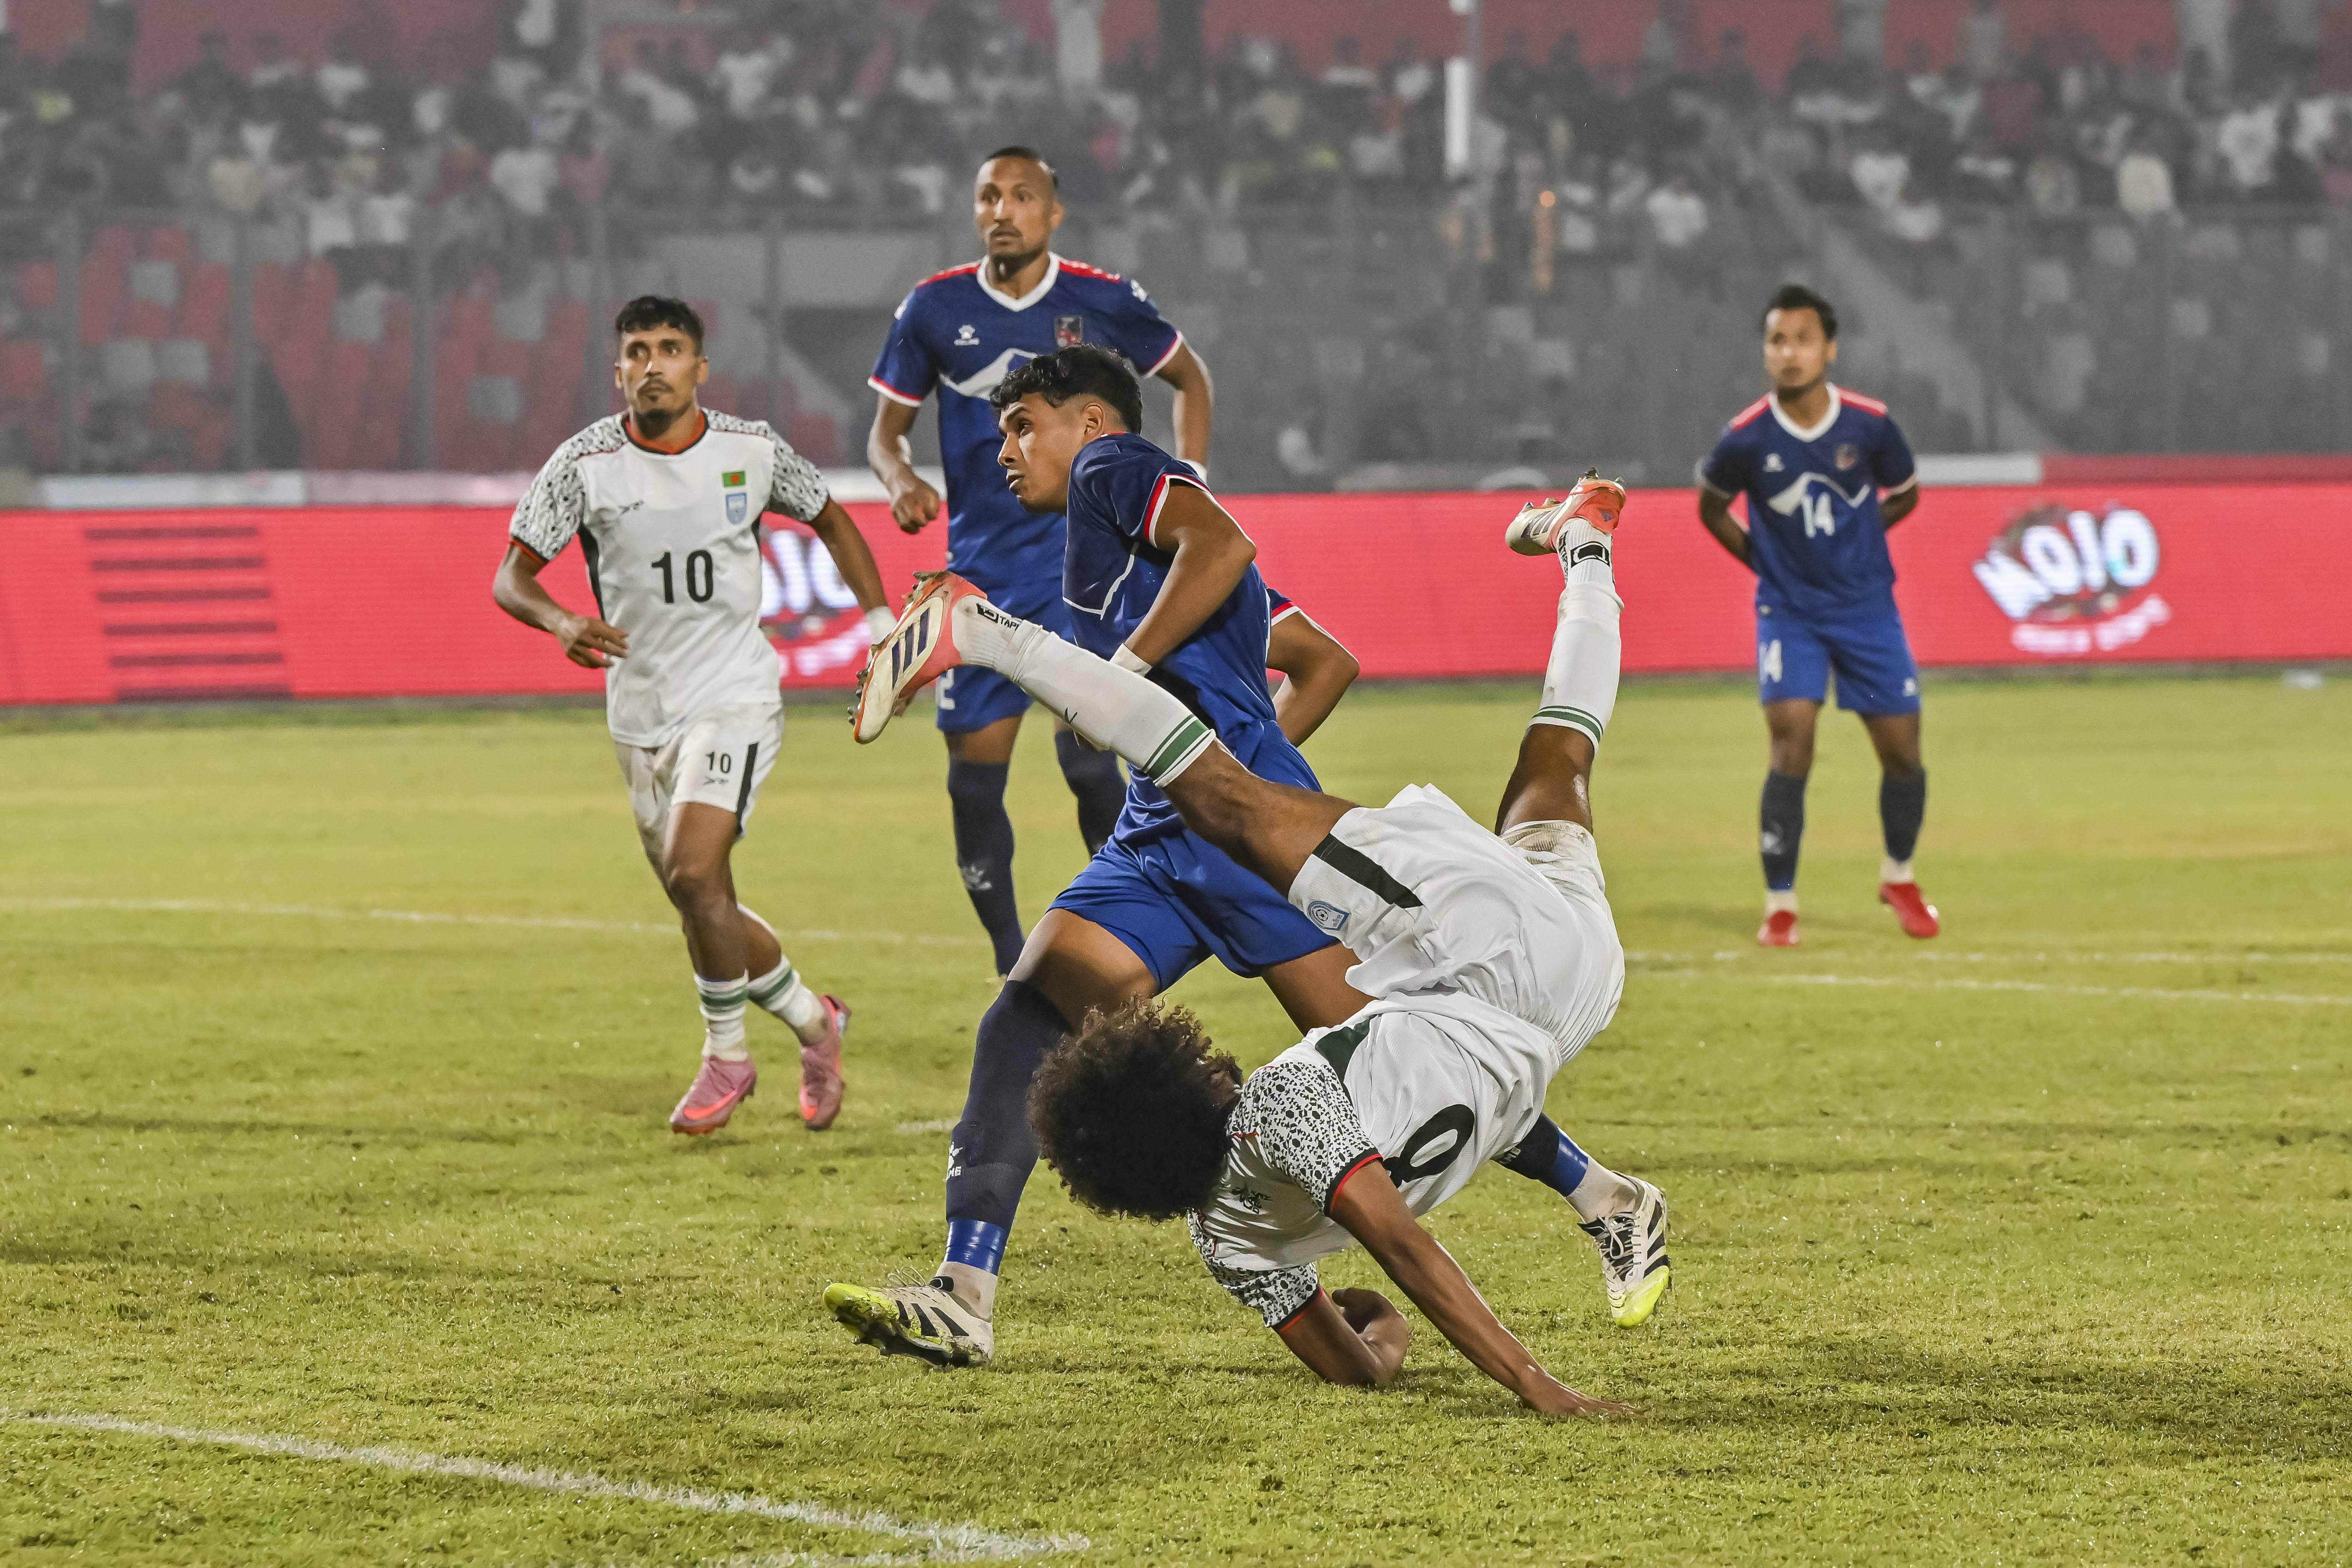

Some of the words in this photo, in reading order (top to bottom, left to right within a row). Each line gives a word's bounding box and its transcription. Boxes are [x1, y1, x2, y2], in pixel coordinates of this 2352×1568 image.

[1802, 493, 1835, 538] 14
[652, 550, 713, 604] 10
[706, 751, 731, 774] 10
